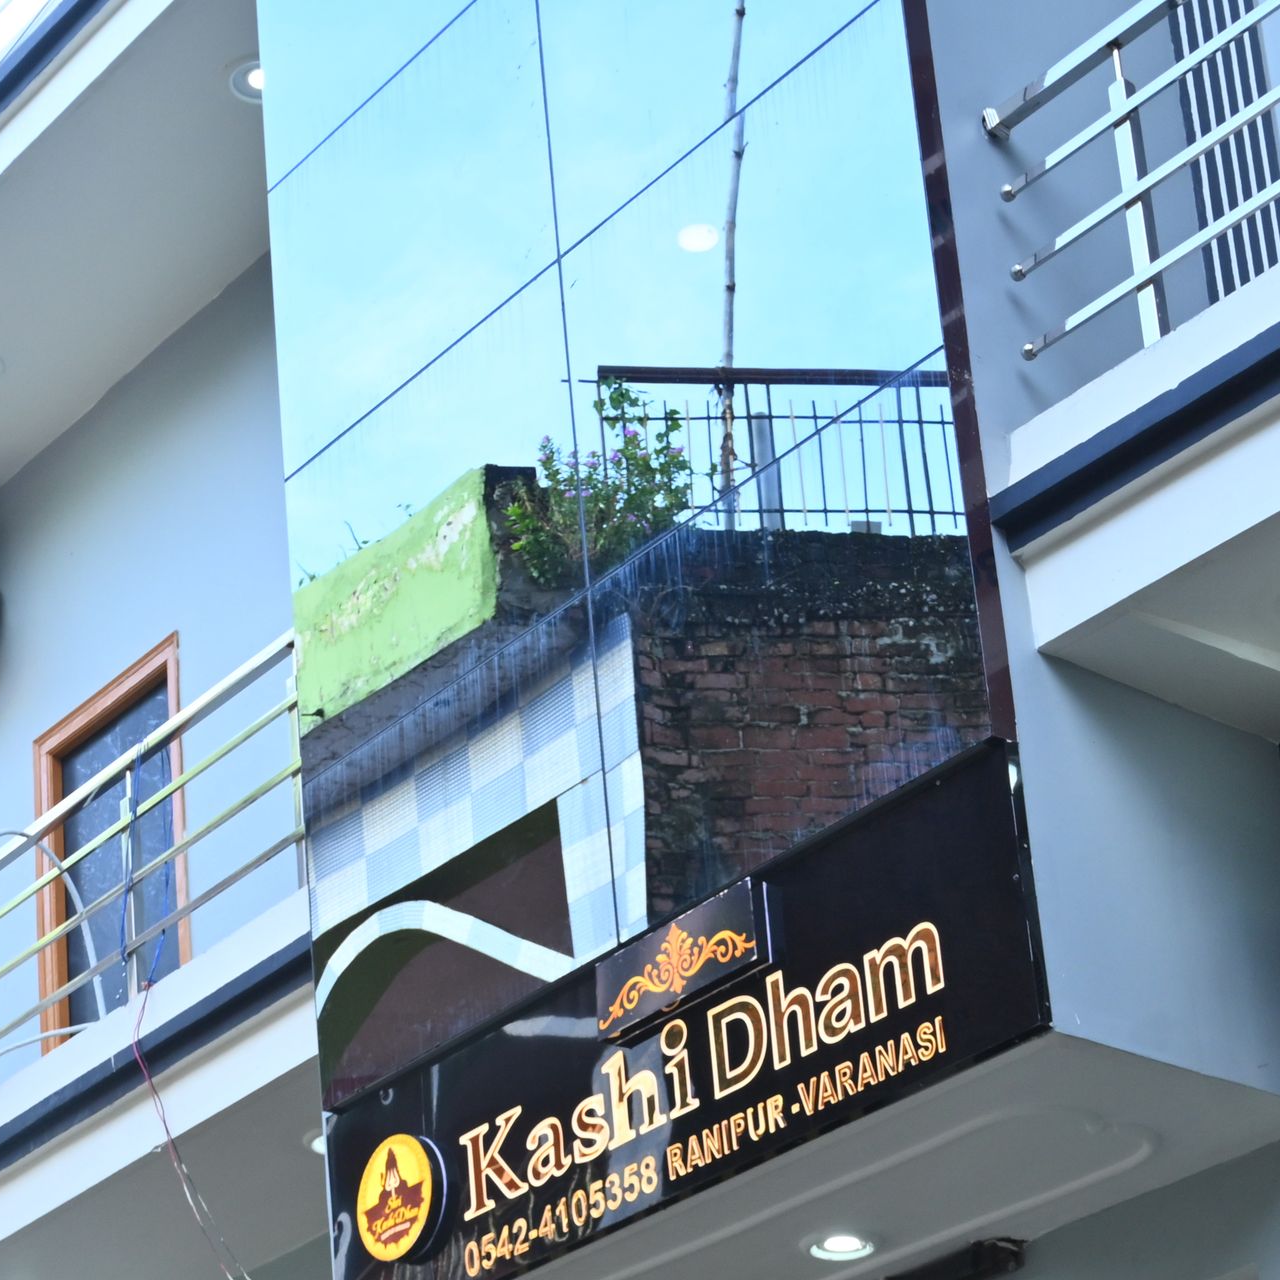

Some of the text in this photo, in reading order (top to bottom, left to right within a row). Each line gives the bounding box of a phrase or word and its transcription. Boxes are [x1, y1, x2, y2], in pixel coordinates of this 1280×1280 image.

[459, 921, 945, 1221] Kashi Dham
[464, 1155, 659, 1278] 0542-4105358
[666, 1094, 787, 1181] RANIPUR
